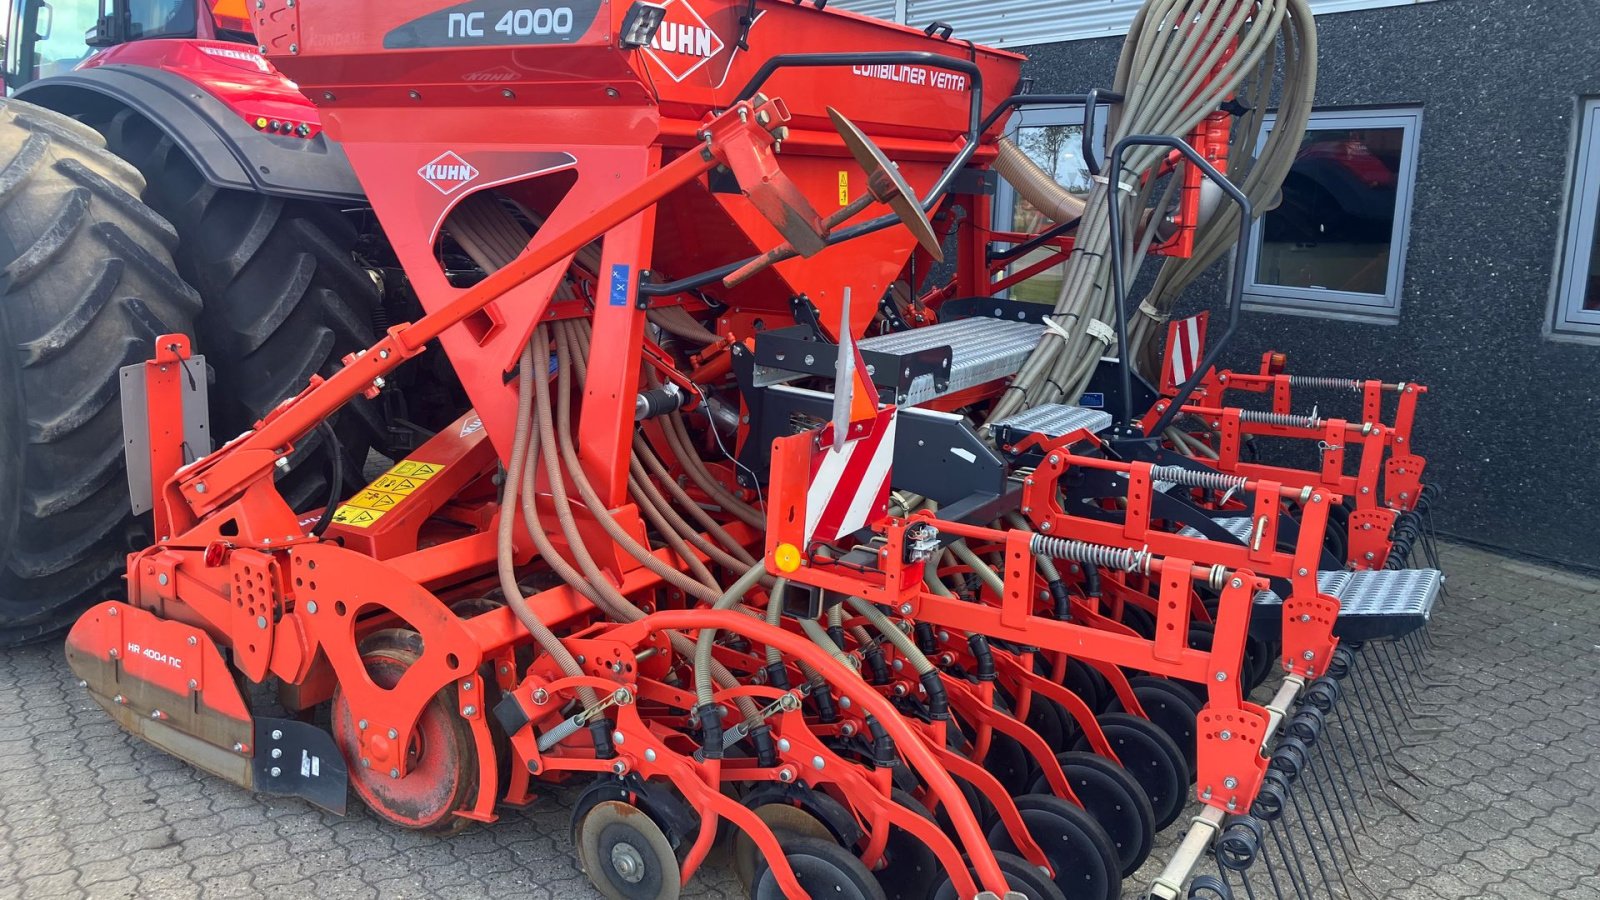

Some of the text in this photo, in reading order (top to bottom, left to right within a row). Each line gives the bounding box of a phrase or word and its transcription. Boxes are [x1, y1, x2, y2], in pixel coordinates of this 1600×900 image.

[494, 7, 573, 36] 4000
[852, 64, 965, 92] COMBILINER VENTA
[425, 164, 471, 181] KUHN
[128, 642, 140, 654] HR
[143, 648, 167, 663] 4004
